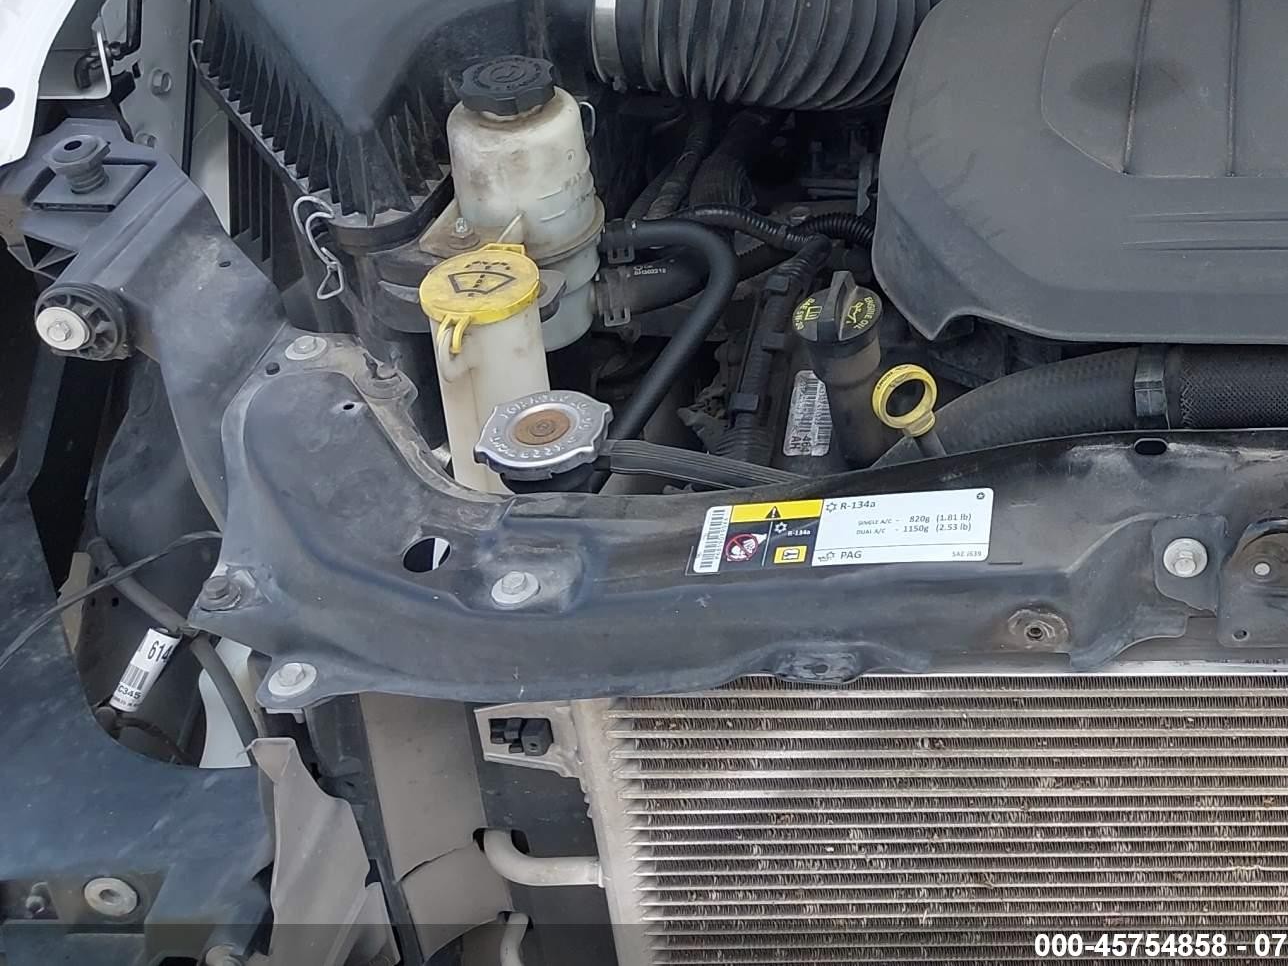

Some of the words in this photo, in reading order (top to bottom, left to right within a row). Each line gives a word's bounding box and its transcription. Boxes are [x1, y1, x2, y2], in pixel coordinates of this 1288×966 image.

[854, 319, 868, 331] OIL
[840, 499, 876, 511] R-134a
[909, 515, 930, 523] 820g
[960, 513, 972, 522] lb)
[903, 525, 929, 534] 1150g
[935, 523, 958, 532] (2.53
[959, 522, 972, 531] lb)
[840, 550, 863, 560] PAG
